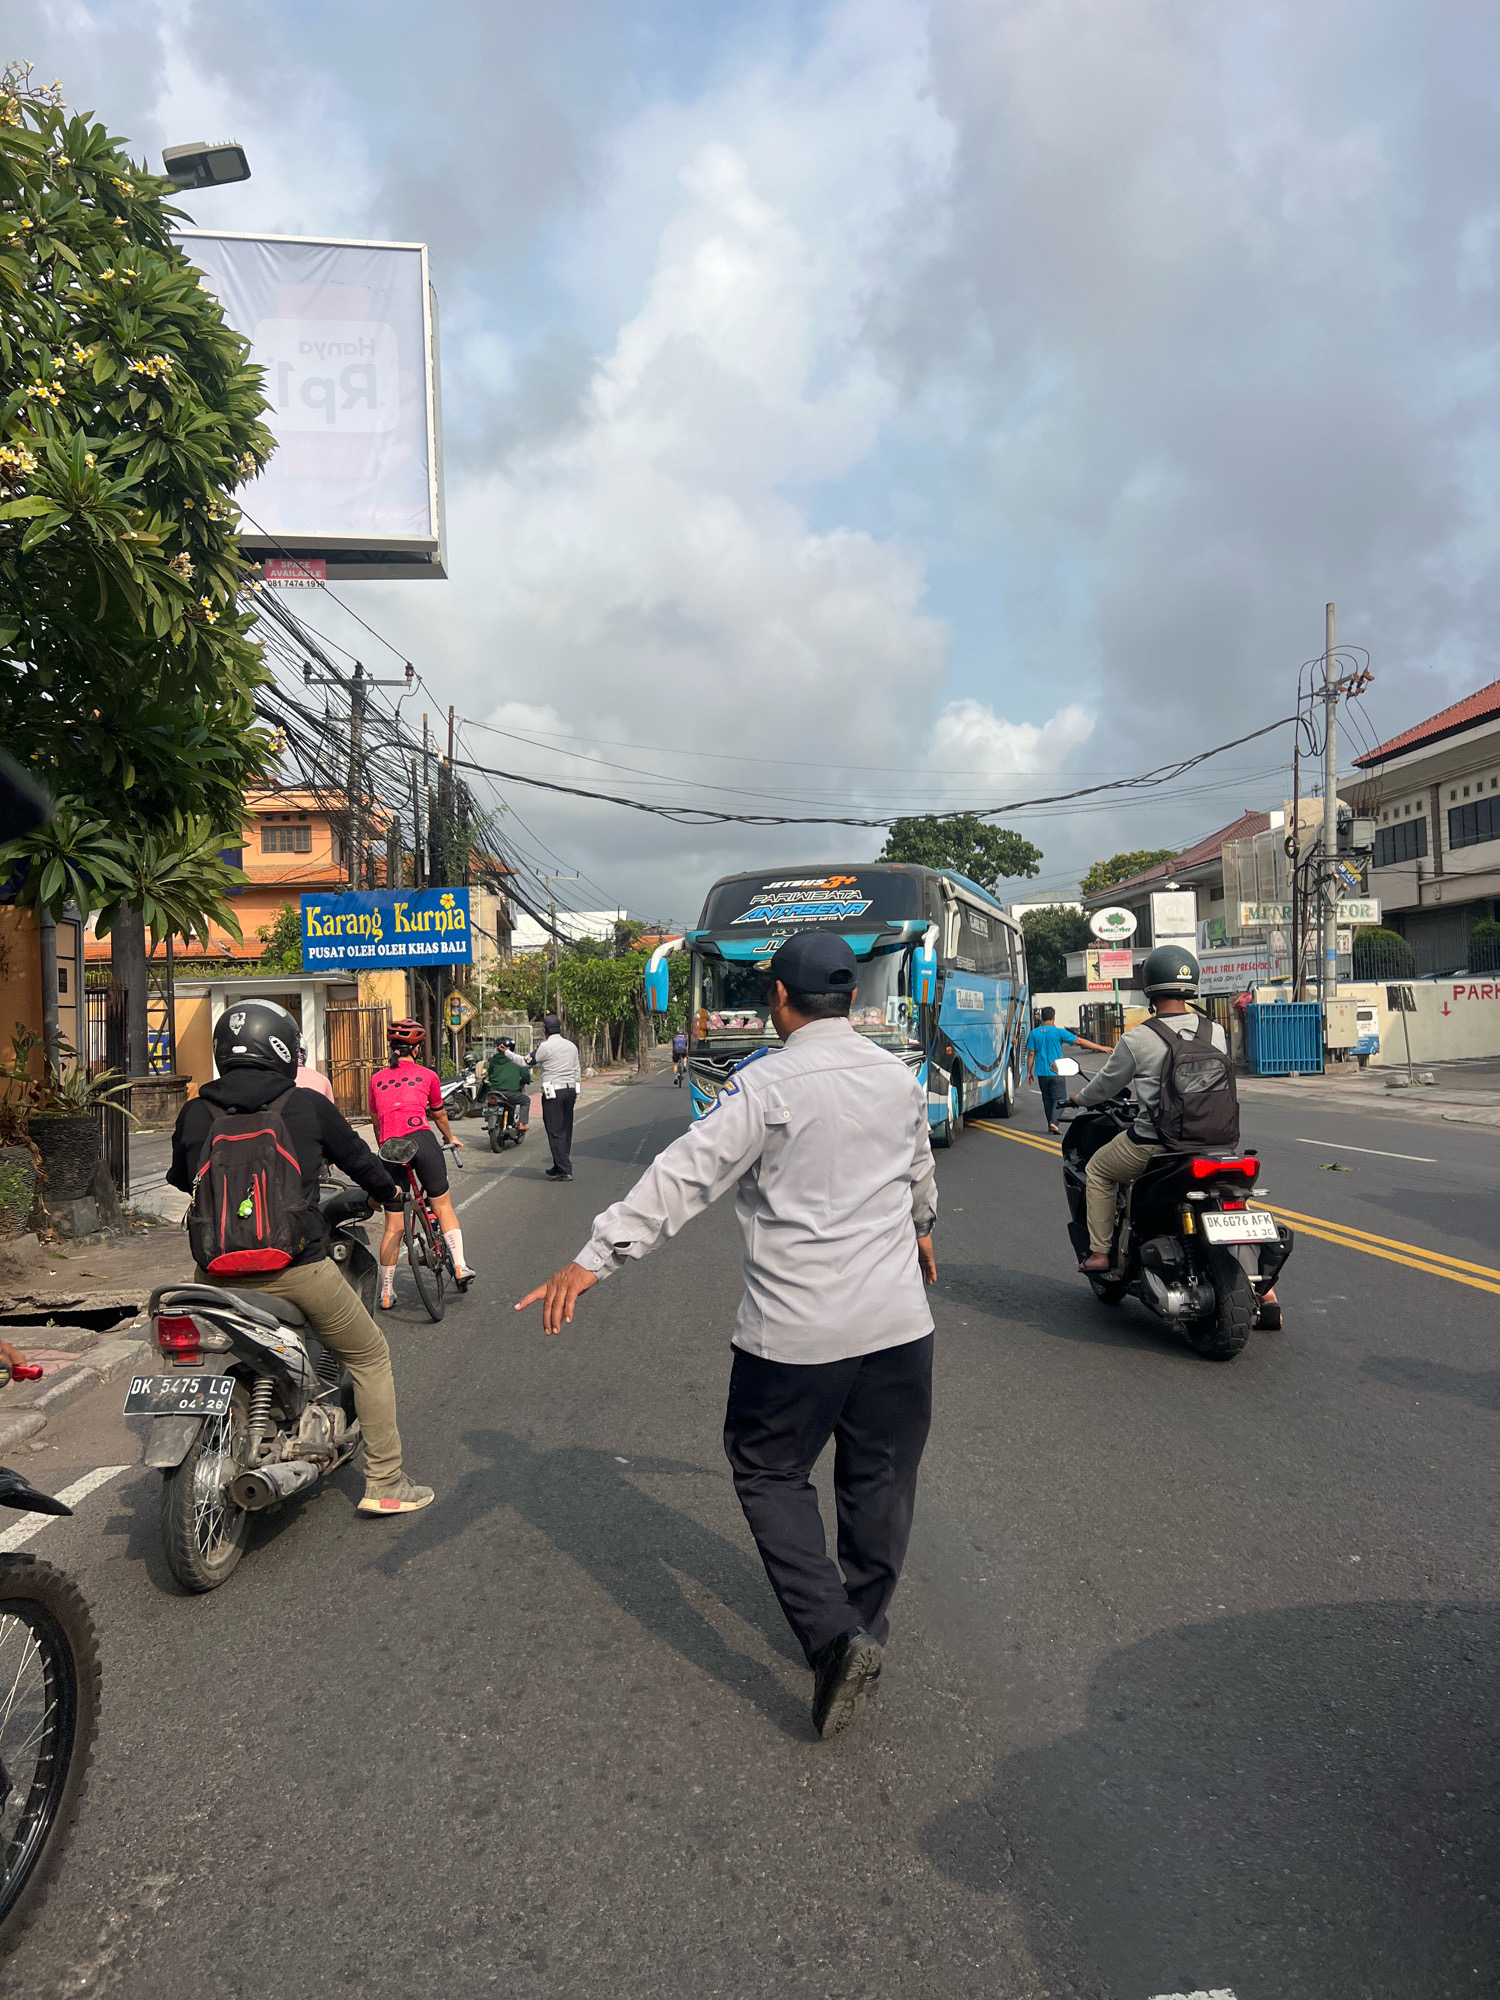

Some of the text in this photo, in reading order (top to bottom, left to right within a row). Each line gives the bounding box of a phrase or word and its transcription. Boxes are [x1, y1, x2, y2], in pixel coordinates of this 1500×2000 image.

[270, 569, 322, 577] AVAILABLE
[749, 889, 863, 905] PARIWISATA
[739, 902, 869, 921] ANTASENA
[306, 902, 467, 944] Karang Kurnia
[308, 940, 467, 959] PUSAT OLEH OLEH KHAS BALI
[1202, 965, 1219, 975] APPLE
[1220, 963, 1235, 973] TREE
[1200, 977, 1213, 985] COME
[1213, 975, 1224, 983] AND
[888, 1001, 909, 1026] 18
[1206, 1216, 1223, 1228] DK
[1251, 1214, 1272, 1226] AFK
[131, 1378, 153, 1395] DK
